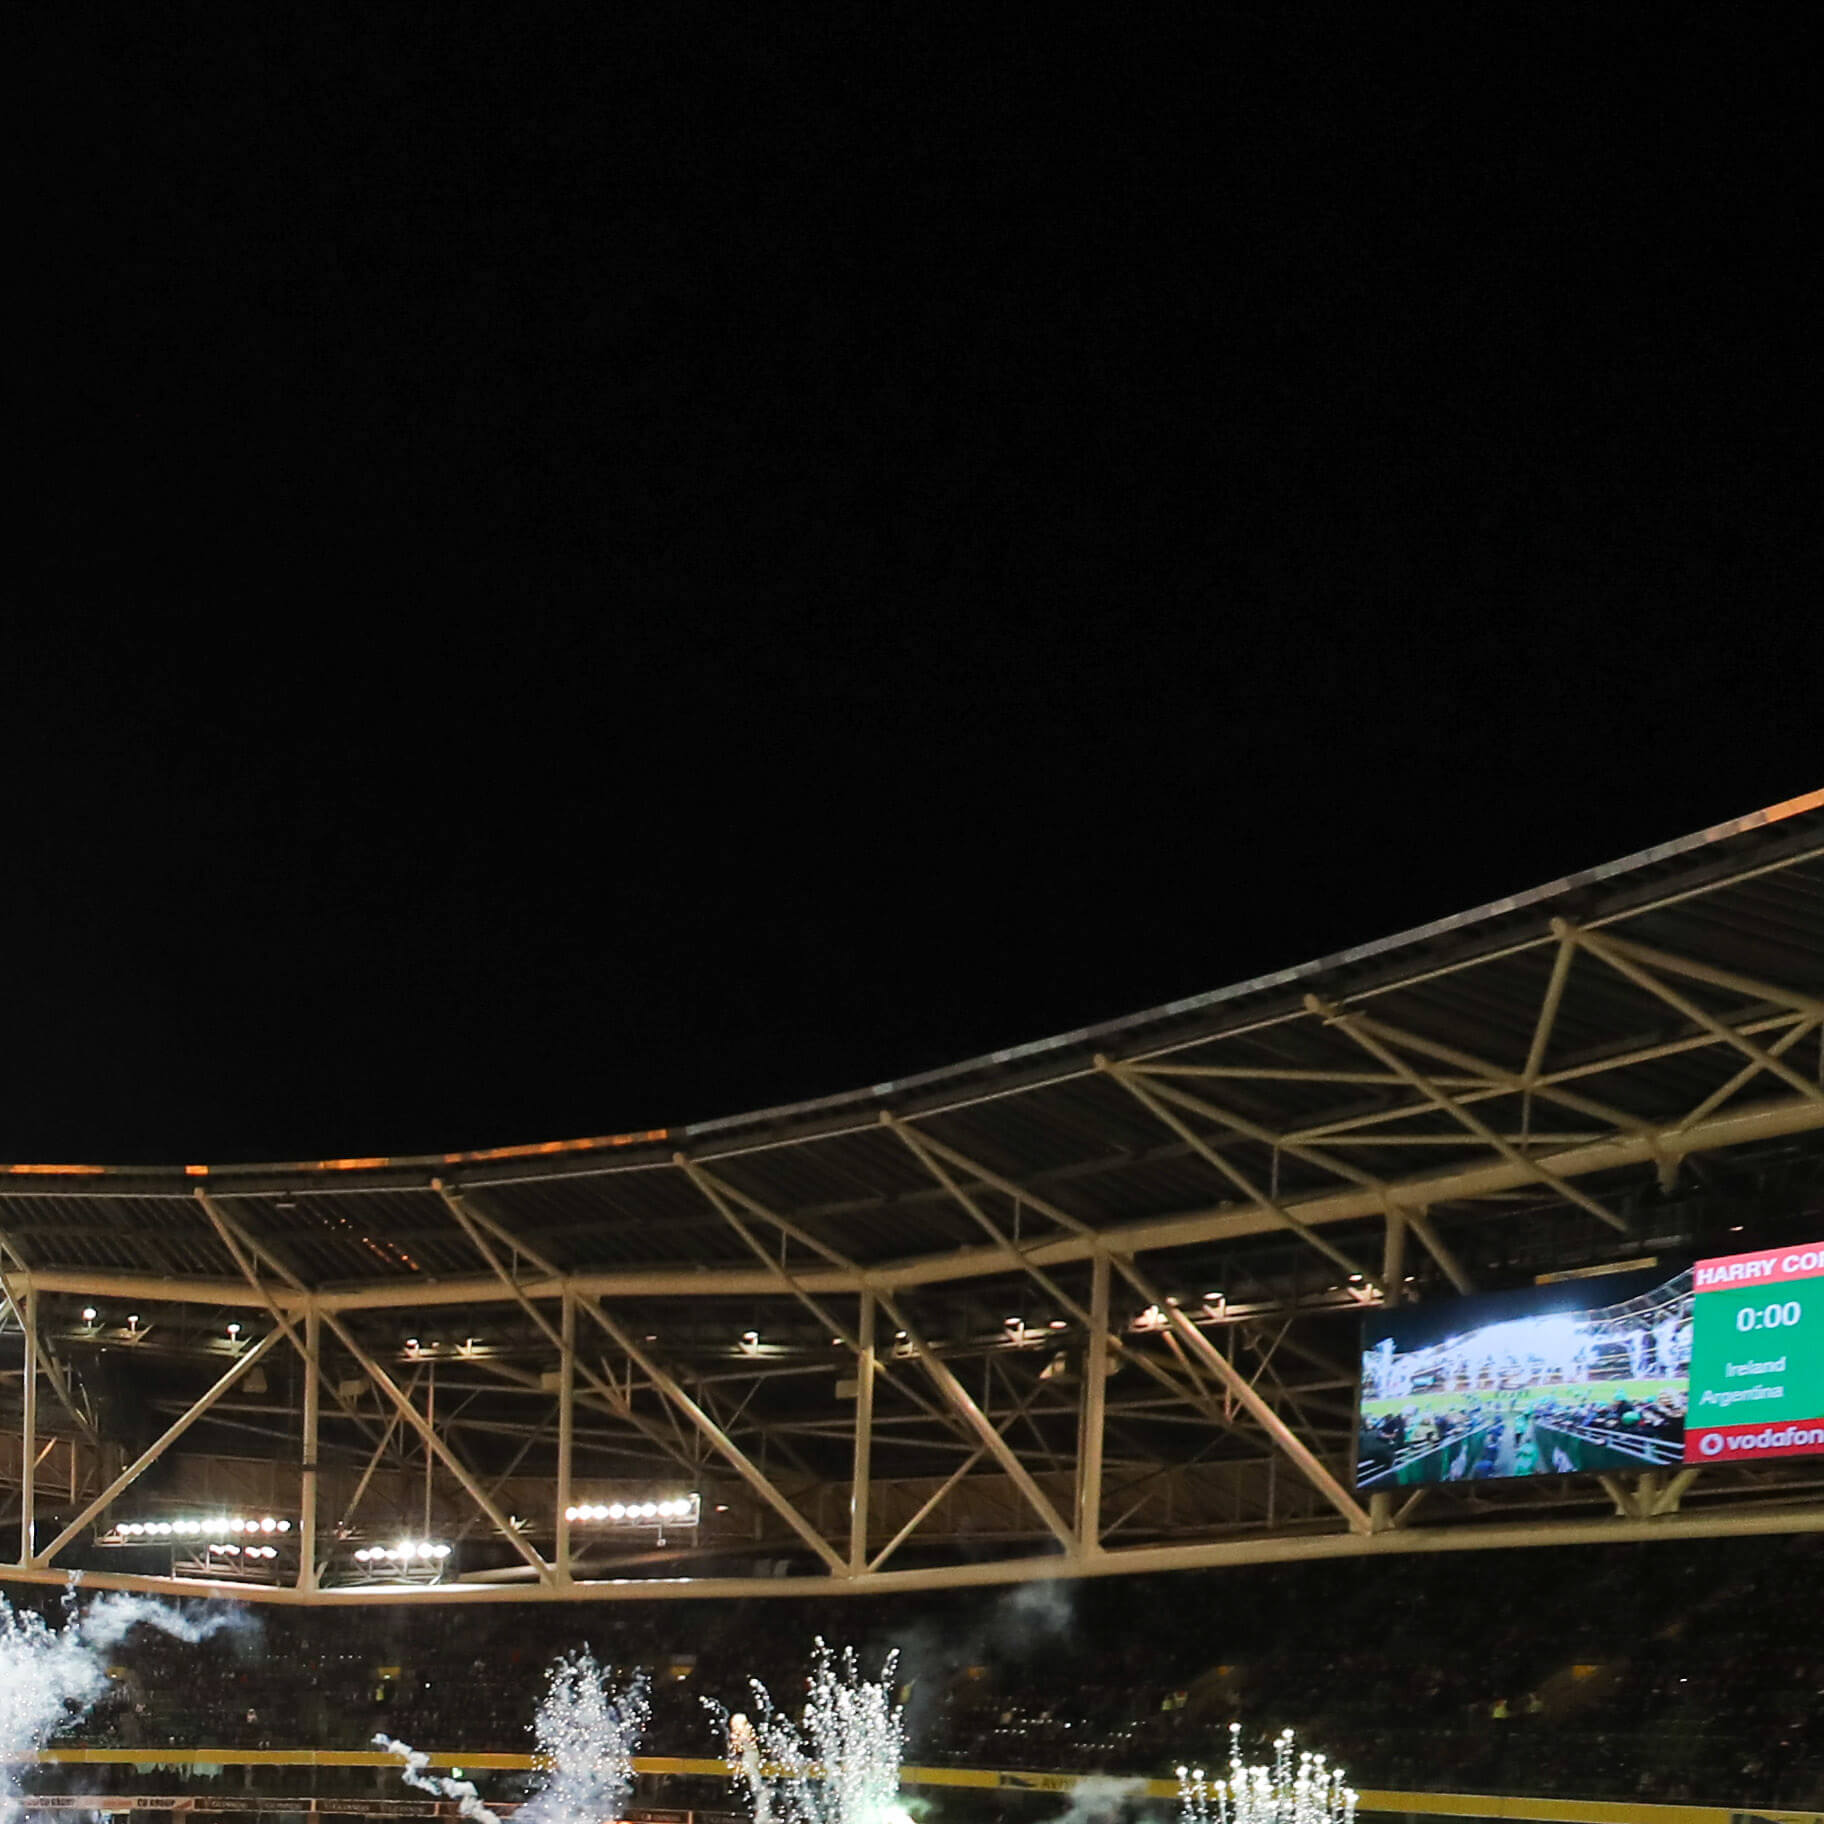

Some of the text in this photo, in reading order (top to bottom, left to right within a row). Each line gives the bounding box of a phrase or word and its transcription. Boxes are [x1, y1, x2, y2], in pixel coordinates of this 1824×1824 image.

[1695, 1257, 1777, 1286] HARRY
[1736, 1301, 1801, 1332] 0:00
[1725, 1356, 1786, 1378] Ireland
[1699, 1384, 1784, 1407] Argentina
